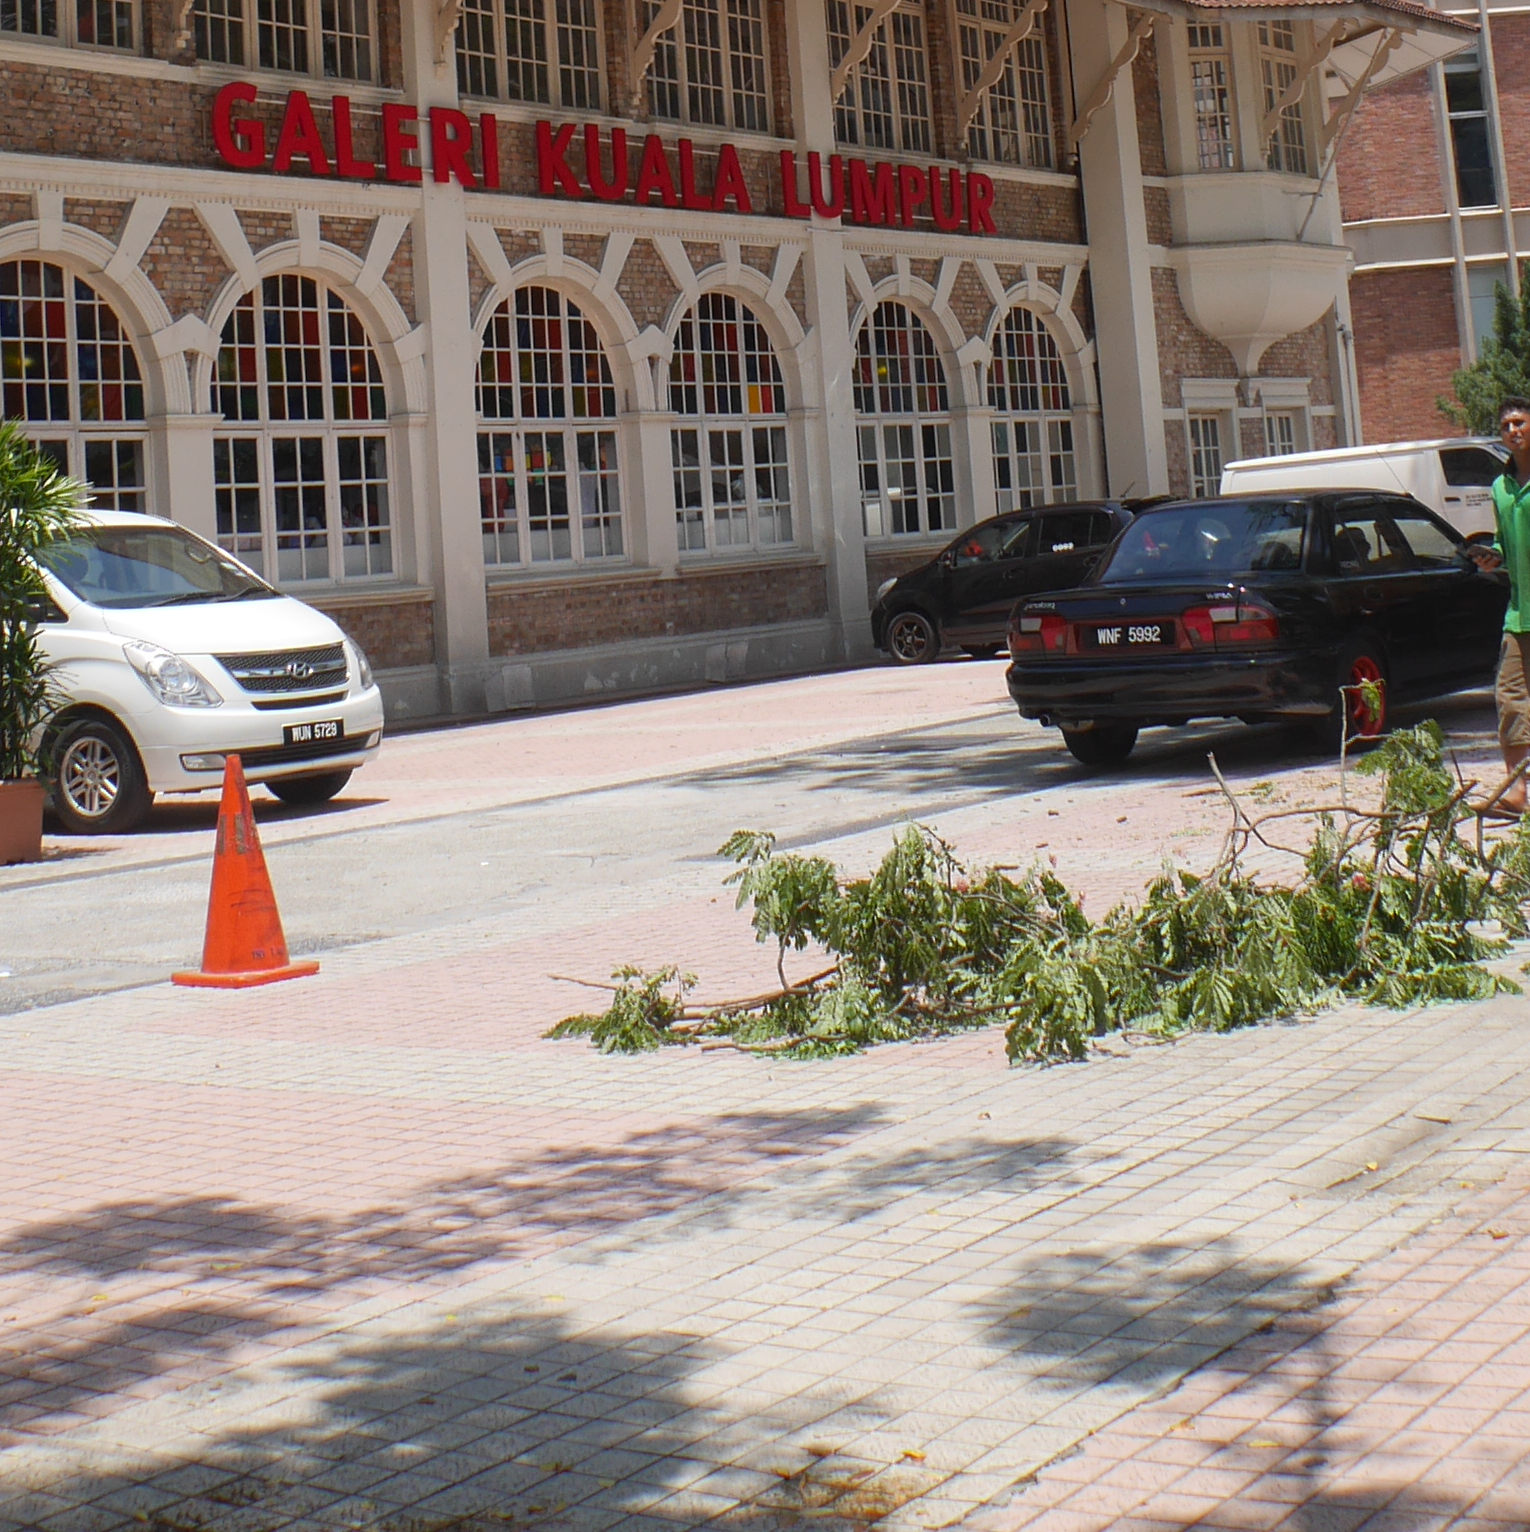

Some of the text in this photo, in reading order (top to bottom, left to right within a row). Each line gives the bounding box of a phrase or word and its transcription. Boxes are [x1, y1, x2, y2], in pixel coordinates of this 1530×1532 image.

[213, 83, 996, 233] GALERI KUALA LUMPUR
[1097, 625, 1161, 645] WNF 5992
[292, 725, 312, 742] WUN
